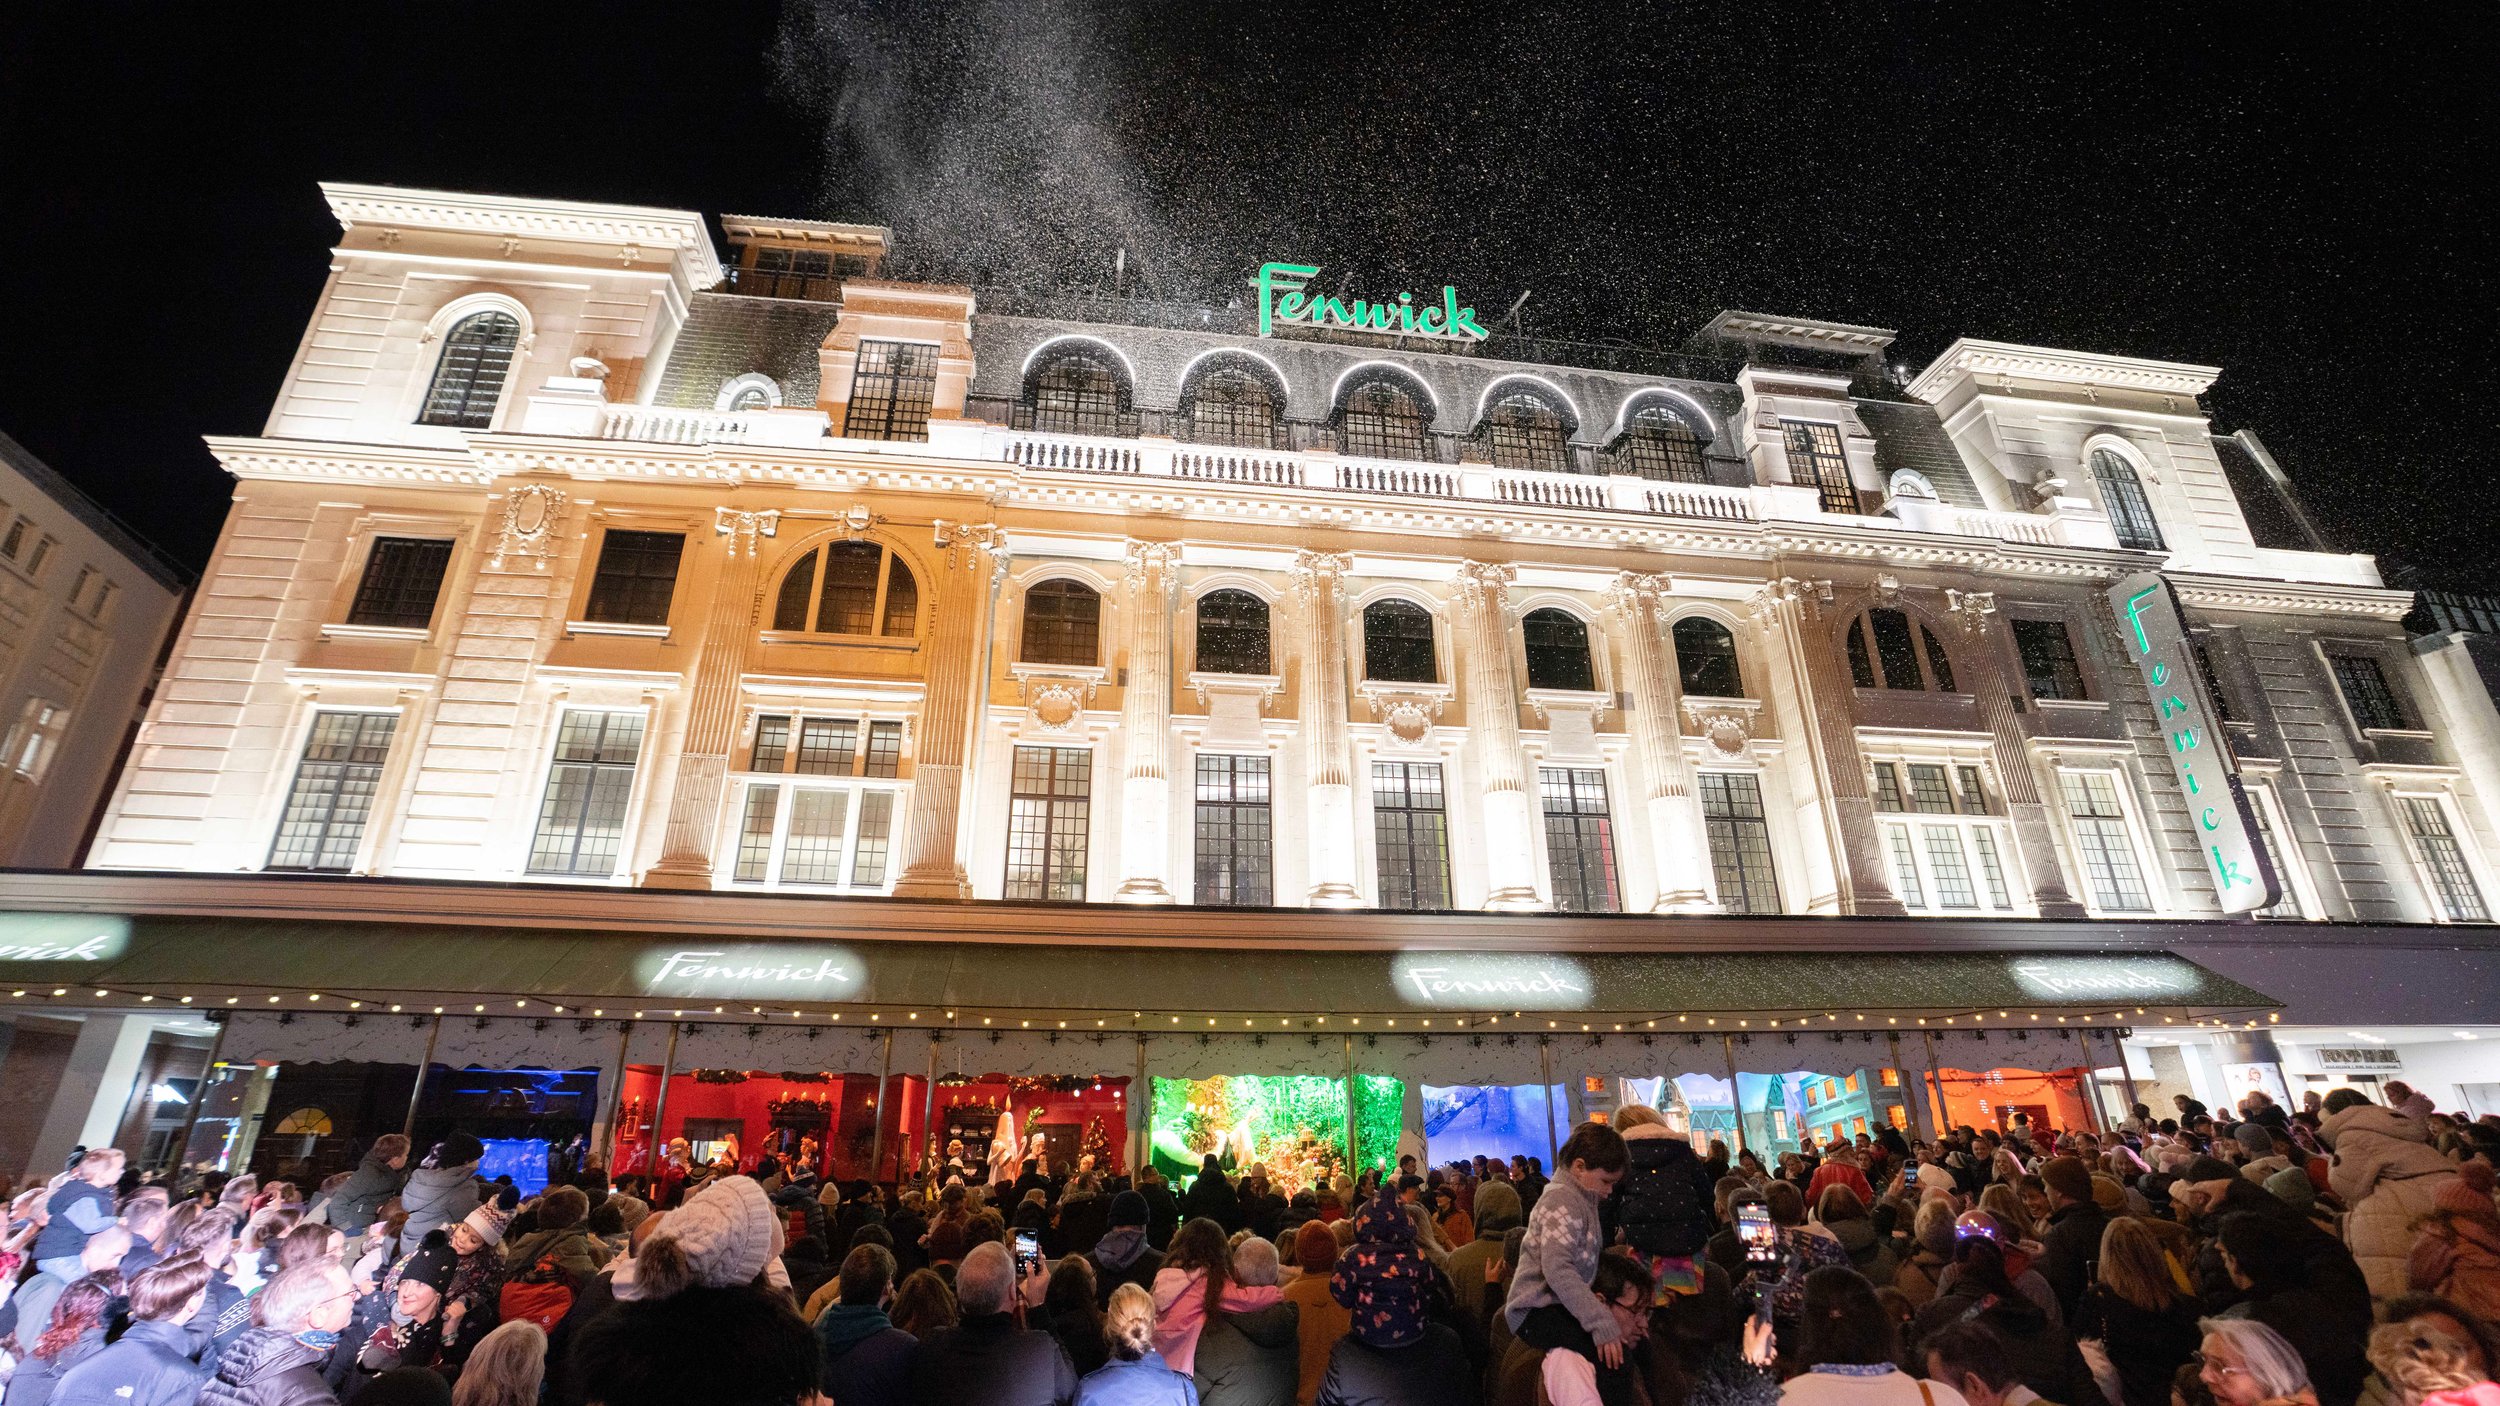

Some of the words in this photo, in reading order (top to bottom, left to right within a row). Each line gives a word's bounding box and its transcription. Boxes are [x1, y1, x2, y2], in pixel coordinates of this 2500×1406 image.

[1249, 262, 1490, 341] Fenwick
[2123, 583, 2252, 889] Fenwick
[652, 952, 849, 983] Fenwick
[2016, 967, 2179, 994] Fenwick
[1405, 968, 1583, 1000] Fenwick
